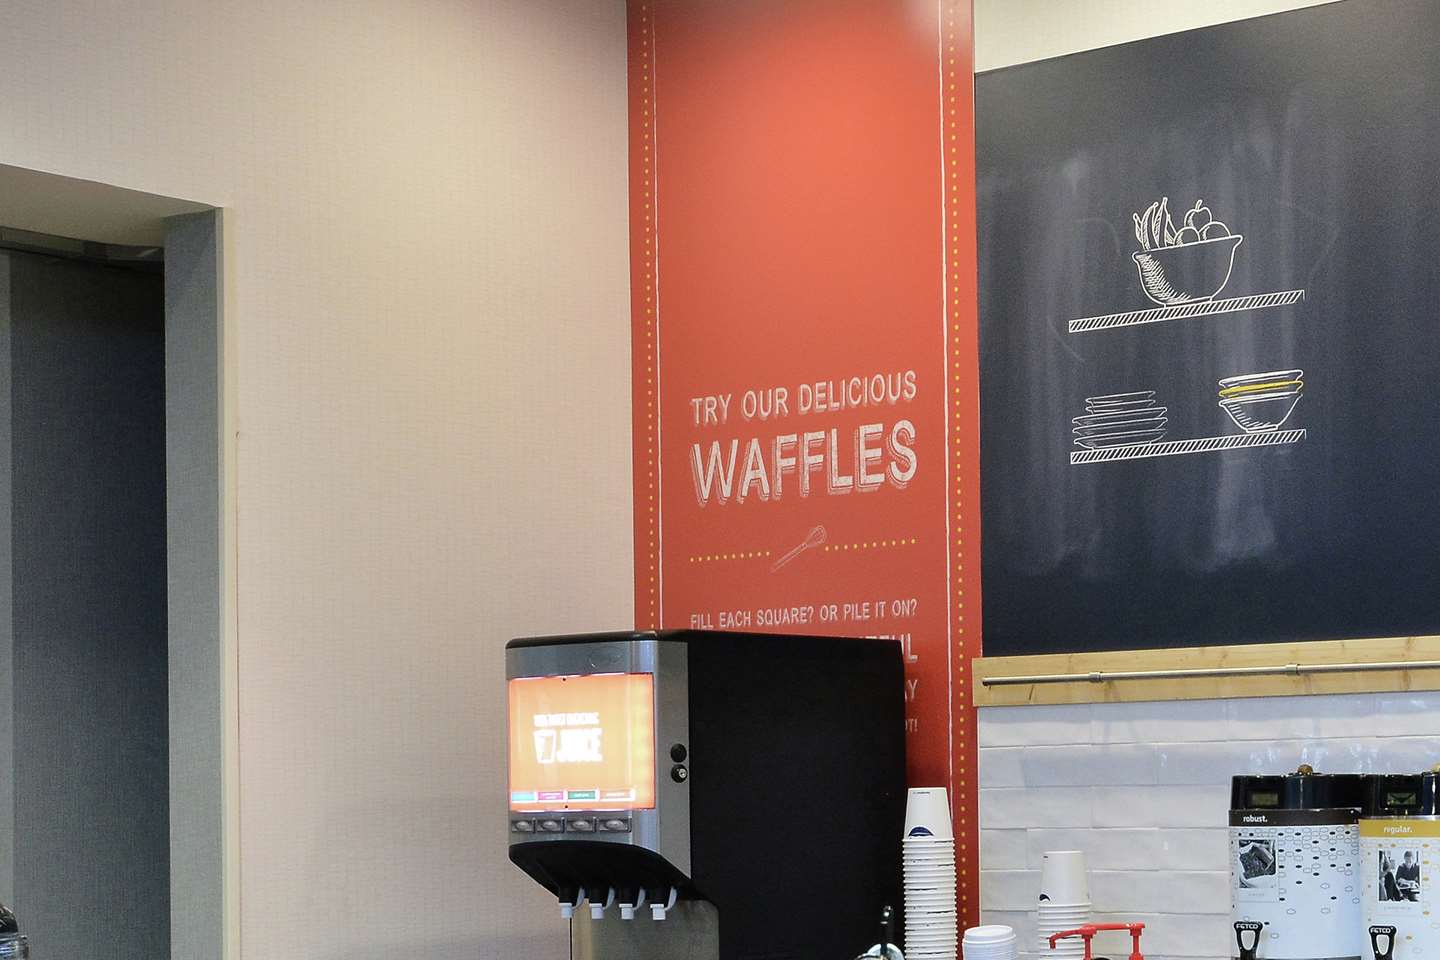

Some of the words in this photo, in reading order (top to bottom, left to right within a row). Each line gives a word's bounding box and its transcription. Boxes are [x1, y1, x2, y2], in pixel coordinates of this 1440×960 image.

[691, 393, 732, 425] TRY
[743, 388, 789, 420] OUR
[799, 370, 917, 413] DELICIOUS
[689, 419, 918, 507] WAFFLES
[719, 611, 750, 629] EACH
[756, 606, 814, 626] SQUARE?
[820, 604, 838, 622] OR
[843, 602, 870, 620] PILE
[875, 601, 887, 617] IT
[892, 598, 917, 617] ON?
